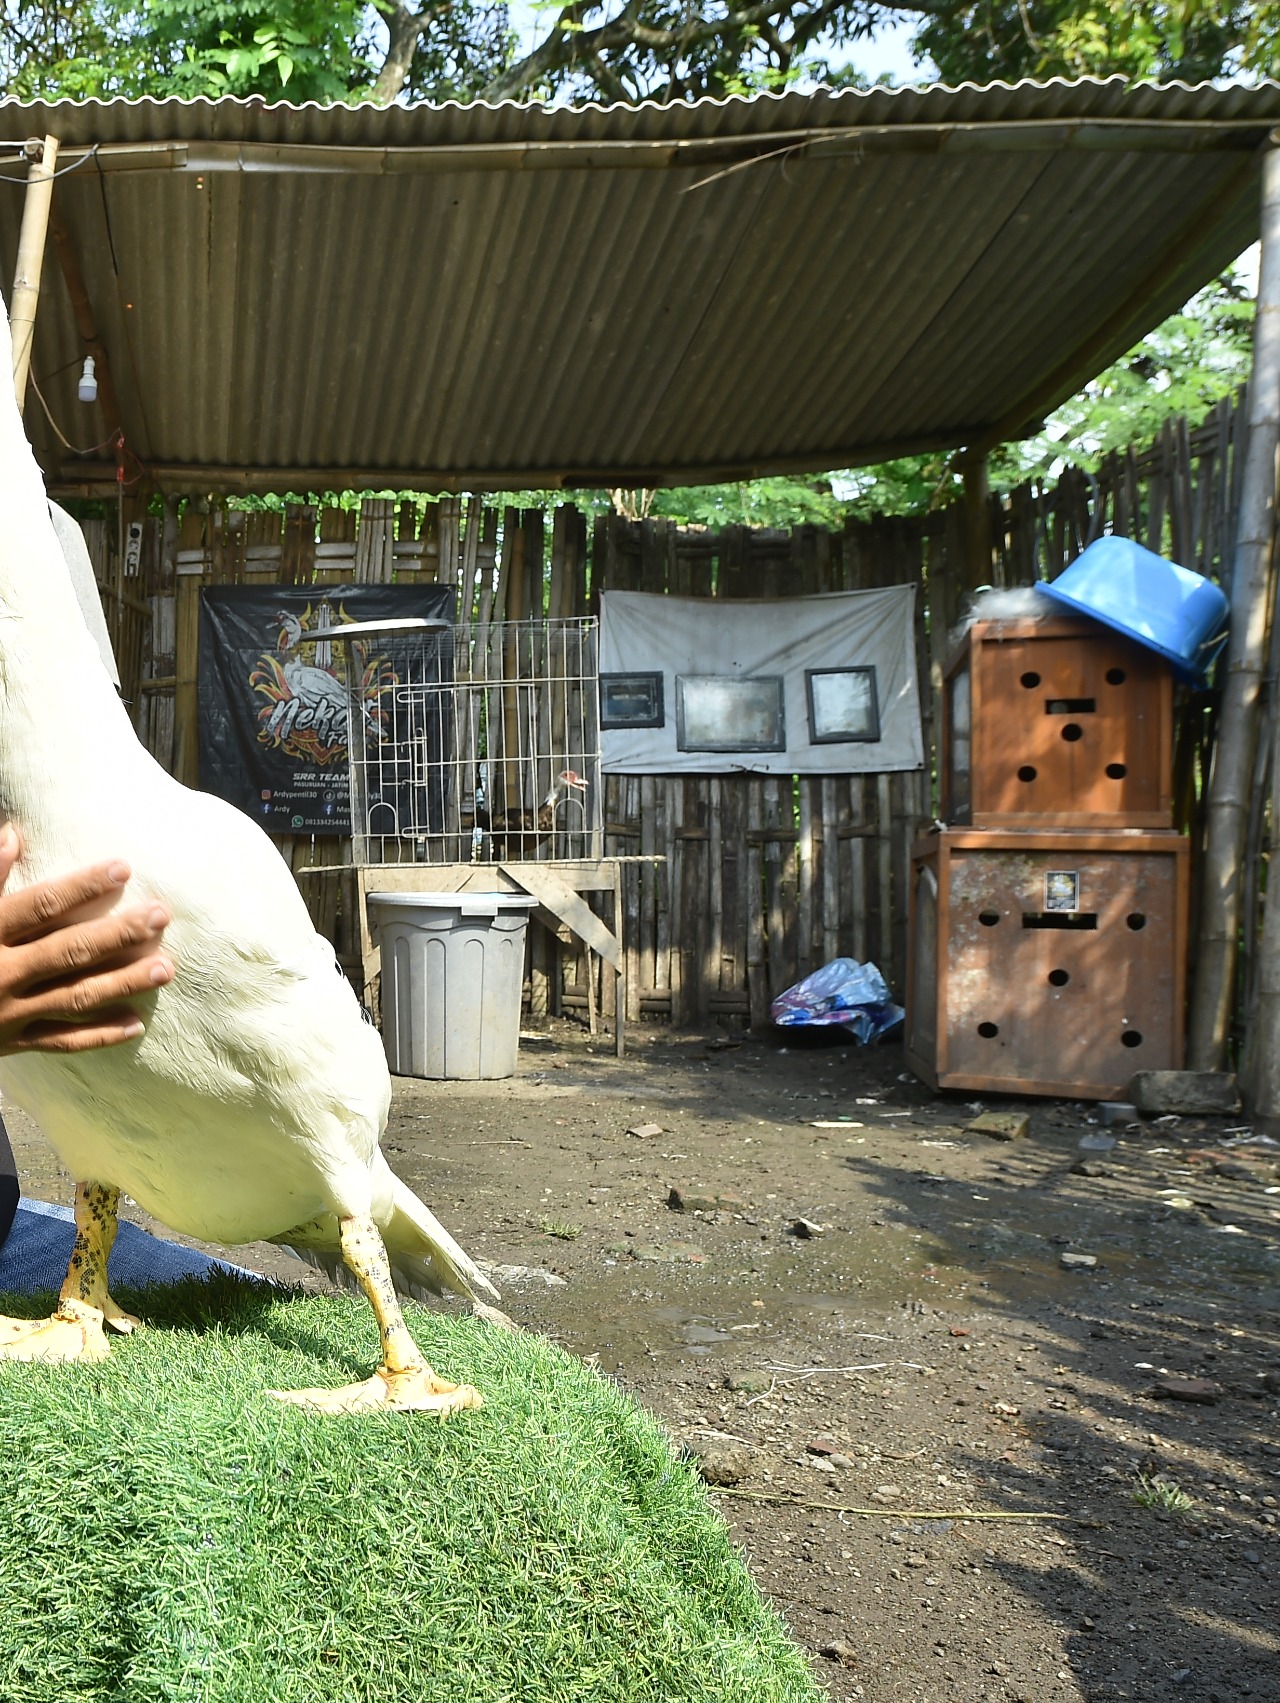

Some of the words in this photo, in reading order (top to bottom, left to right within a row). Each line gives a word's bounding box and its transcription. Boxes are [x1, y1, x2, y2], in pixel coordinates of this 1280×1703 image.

[292, 772, 316, 781] SRR
[319, 772, 351, 781] TEAM
[331, 781, 349, 789] JATIM
[273, 790, 318, 799] Ardypentil30
[273, 805, 291, 813] Ardy
